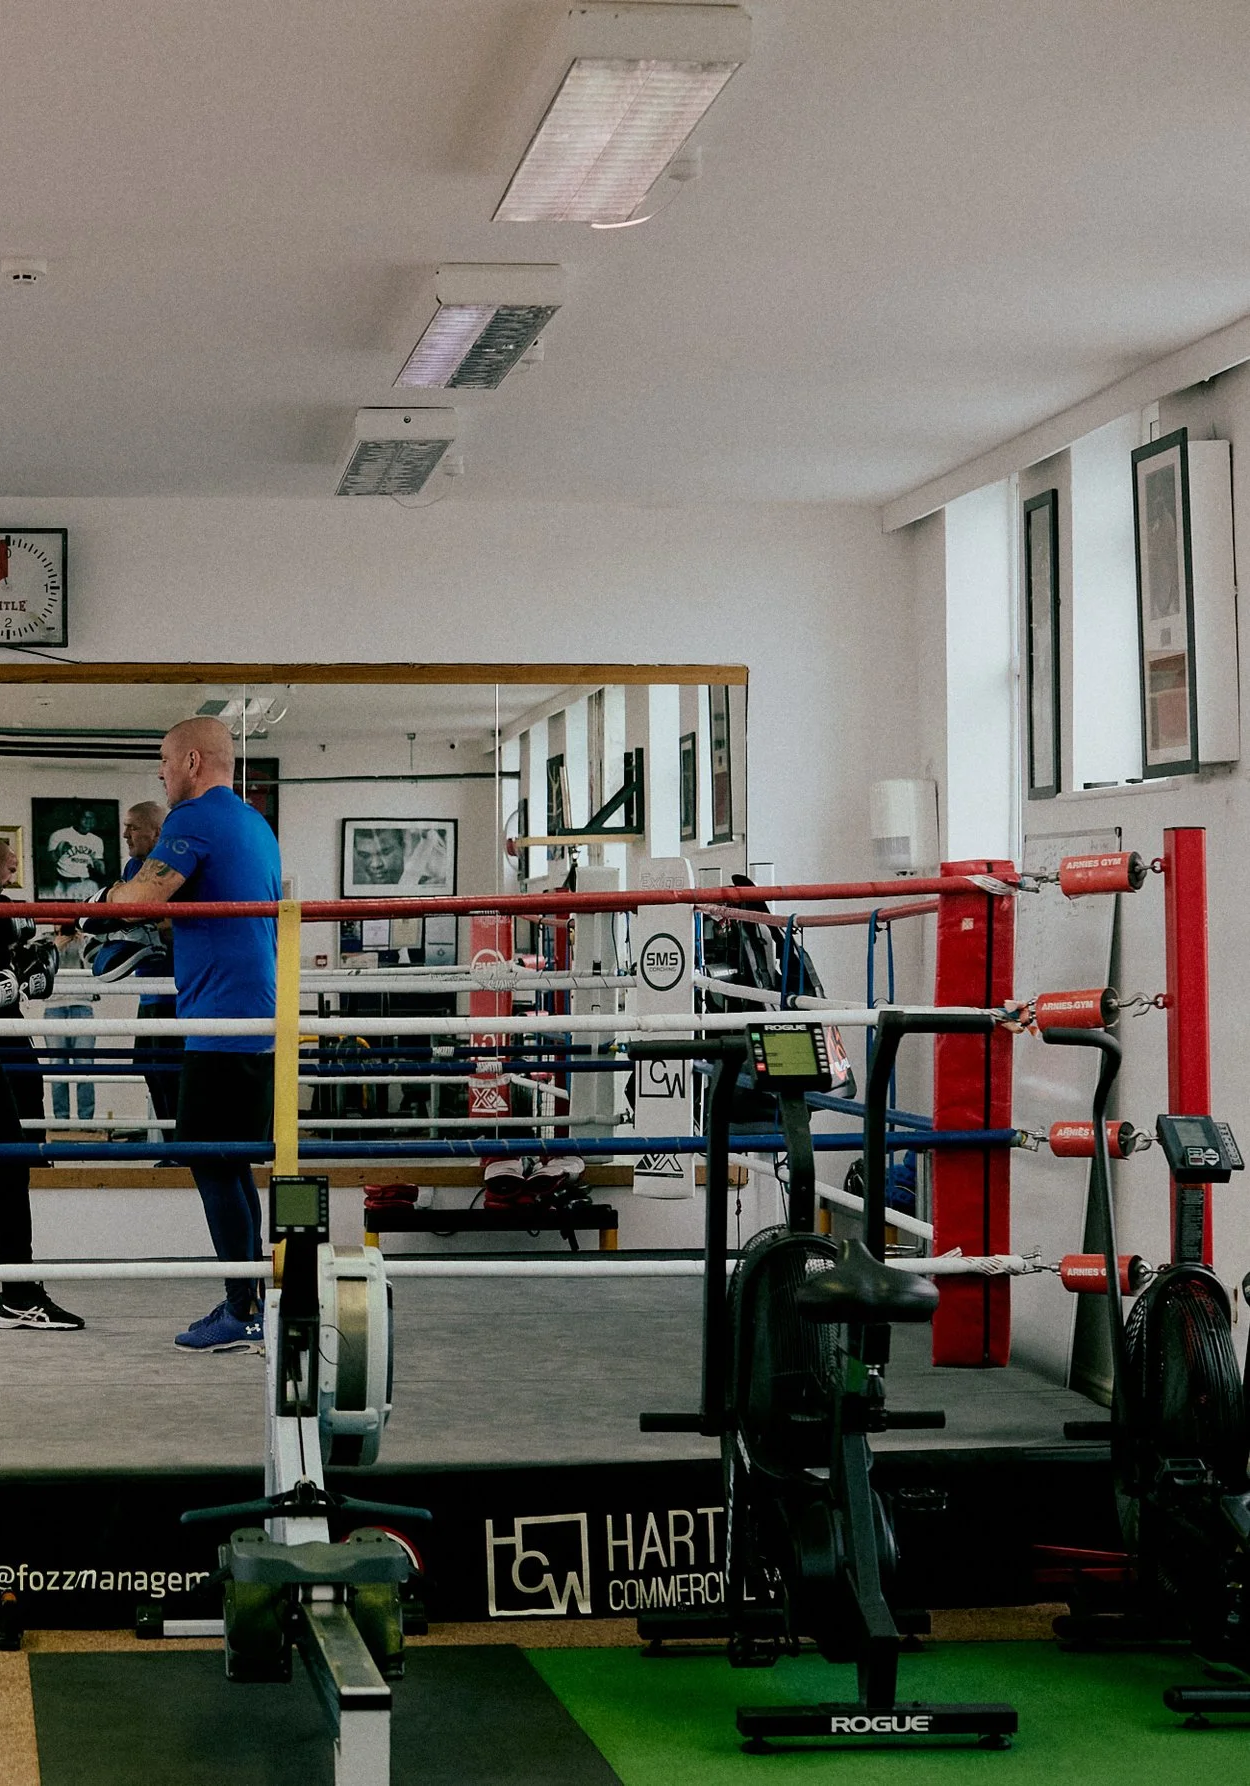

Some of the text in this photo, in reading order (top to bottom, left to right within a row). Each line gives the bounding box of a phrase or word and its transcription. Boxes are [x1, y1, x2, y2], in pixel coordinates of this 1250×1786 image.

[4, 617, 12, 628] 2
[1066, 857, 1122, 870] ARNIES GYM
[646, 952, 678, 966] SMS
[1041, 1001, 1073, 1011] ARNIES
[1057, 1127, 1090, 1138] ARNIES
[1067, 1266, 1100, 1277] ARNIES
[831, 1715, 930, 1733] ROGUE
